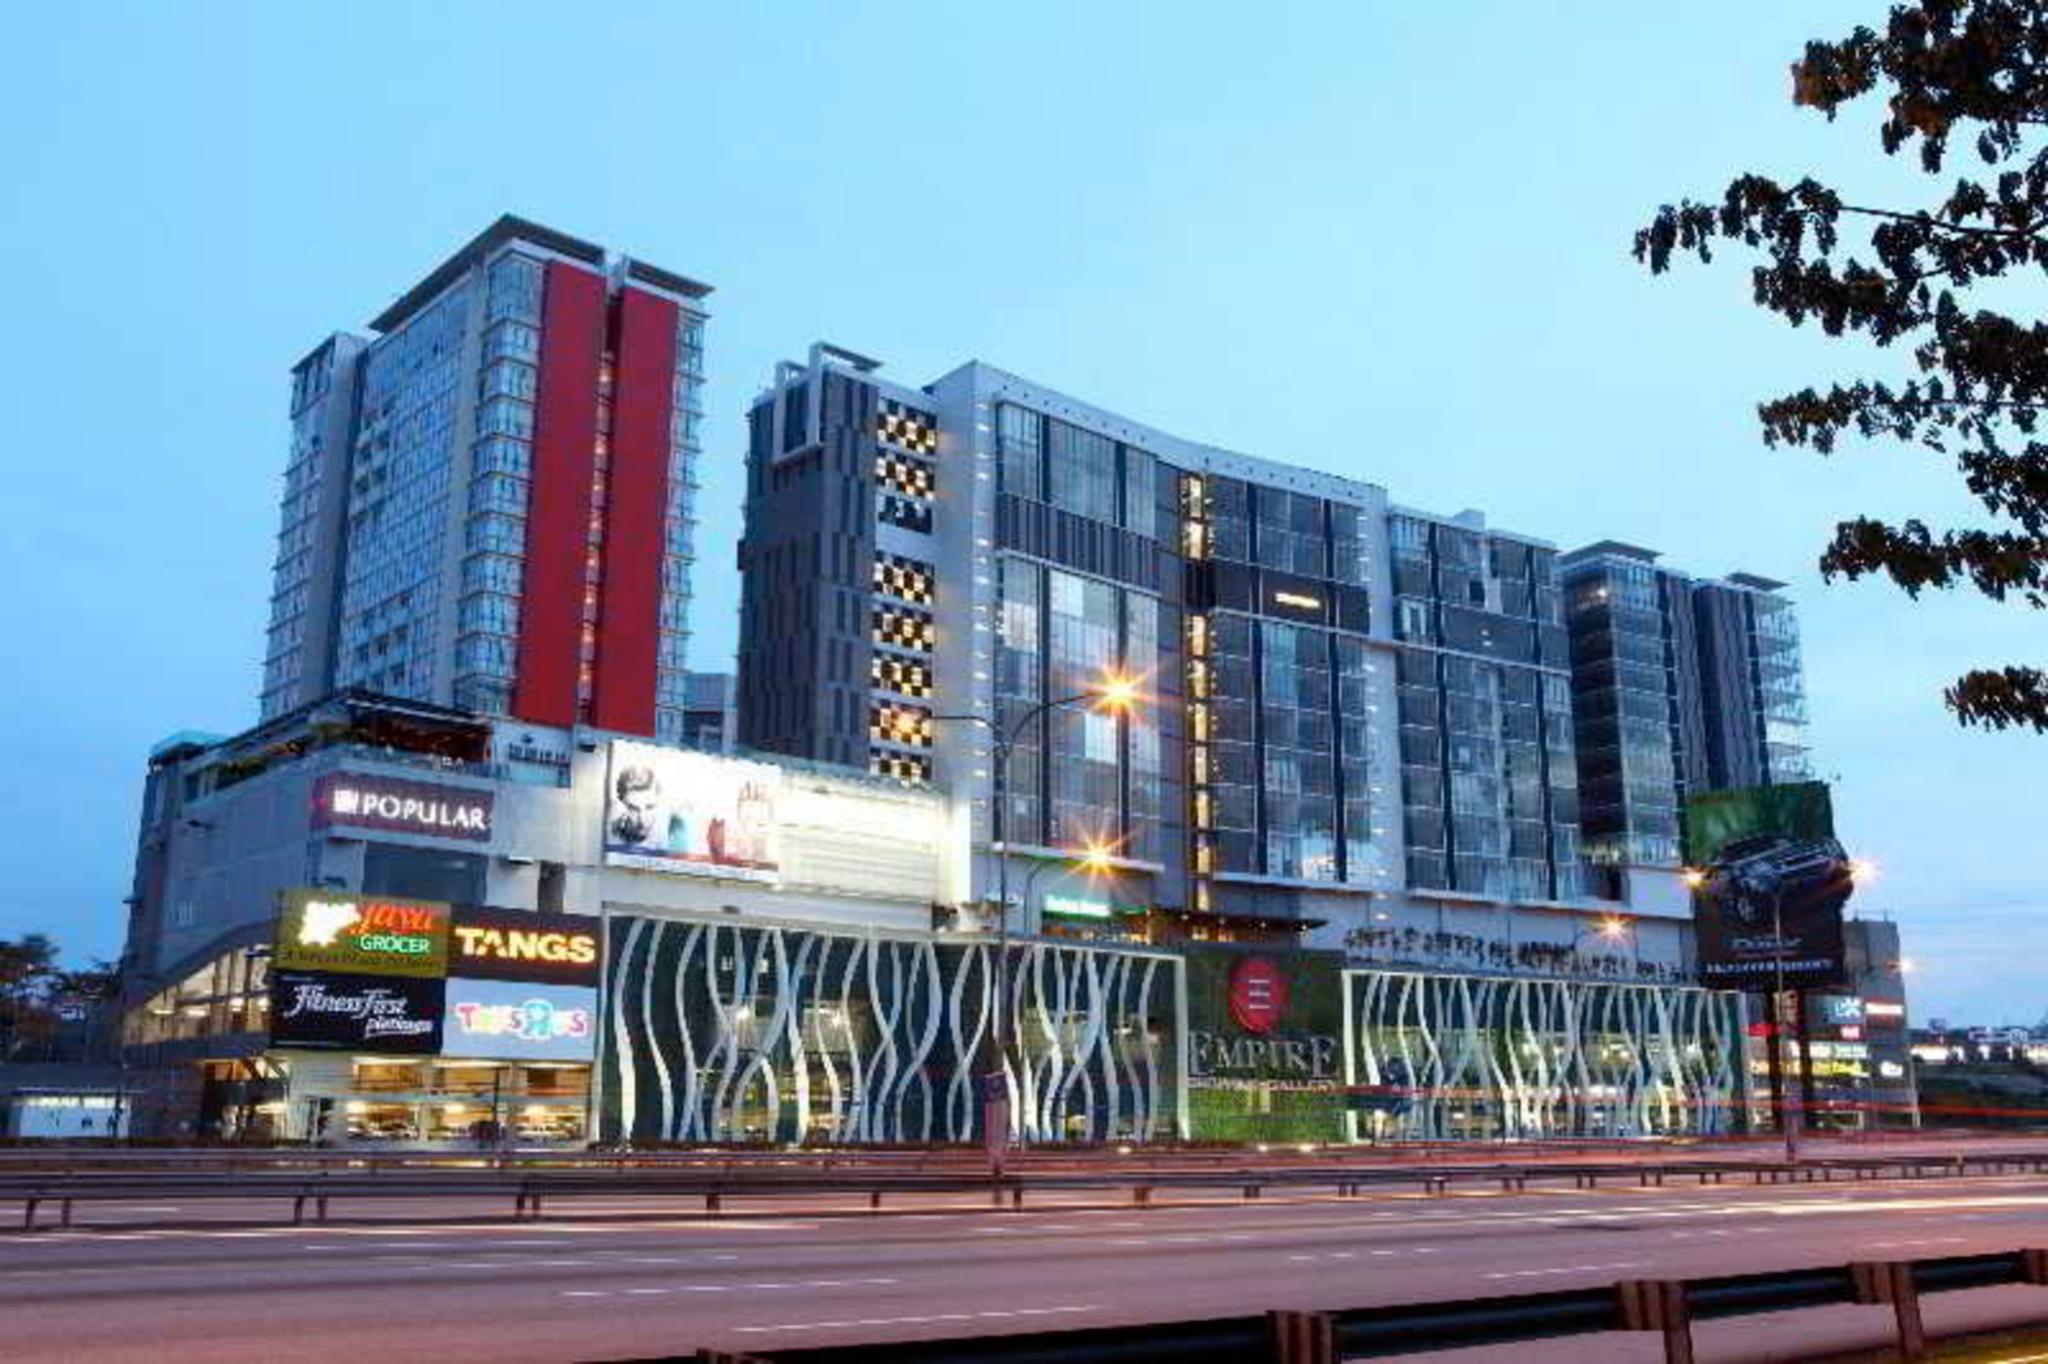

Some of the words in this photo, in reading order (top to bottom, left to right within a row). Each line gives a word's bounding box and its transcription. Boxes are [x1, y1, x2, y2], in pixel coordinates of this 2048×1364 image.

[362, 793, 487, 830] POPULAR
[359, 933, 431, 954] GROCER
[455, 926, 596, 964] TANGS
[552, 1009, 588, 1037] S
[1187, 1031, 1337, 1078] EMPIRE
